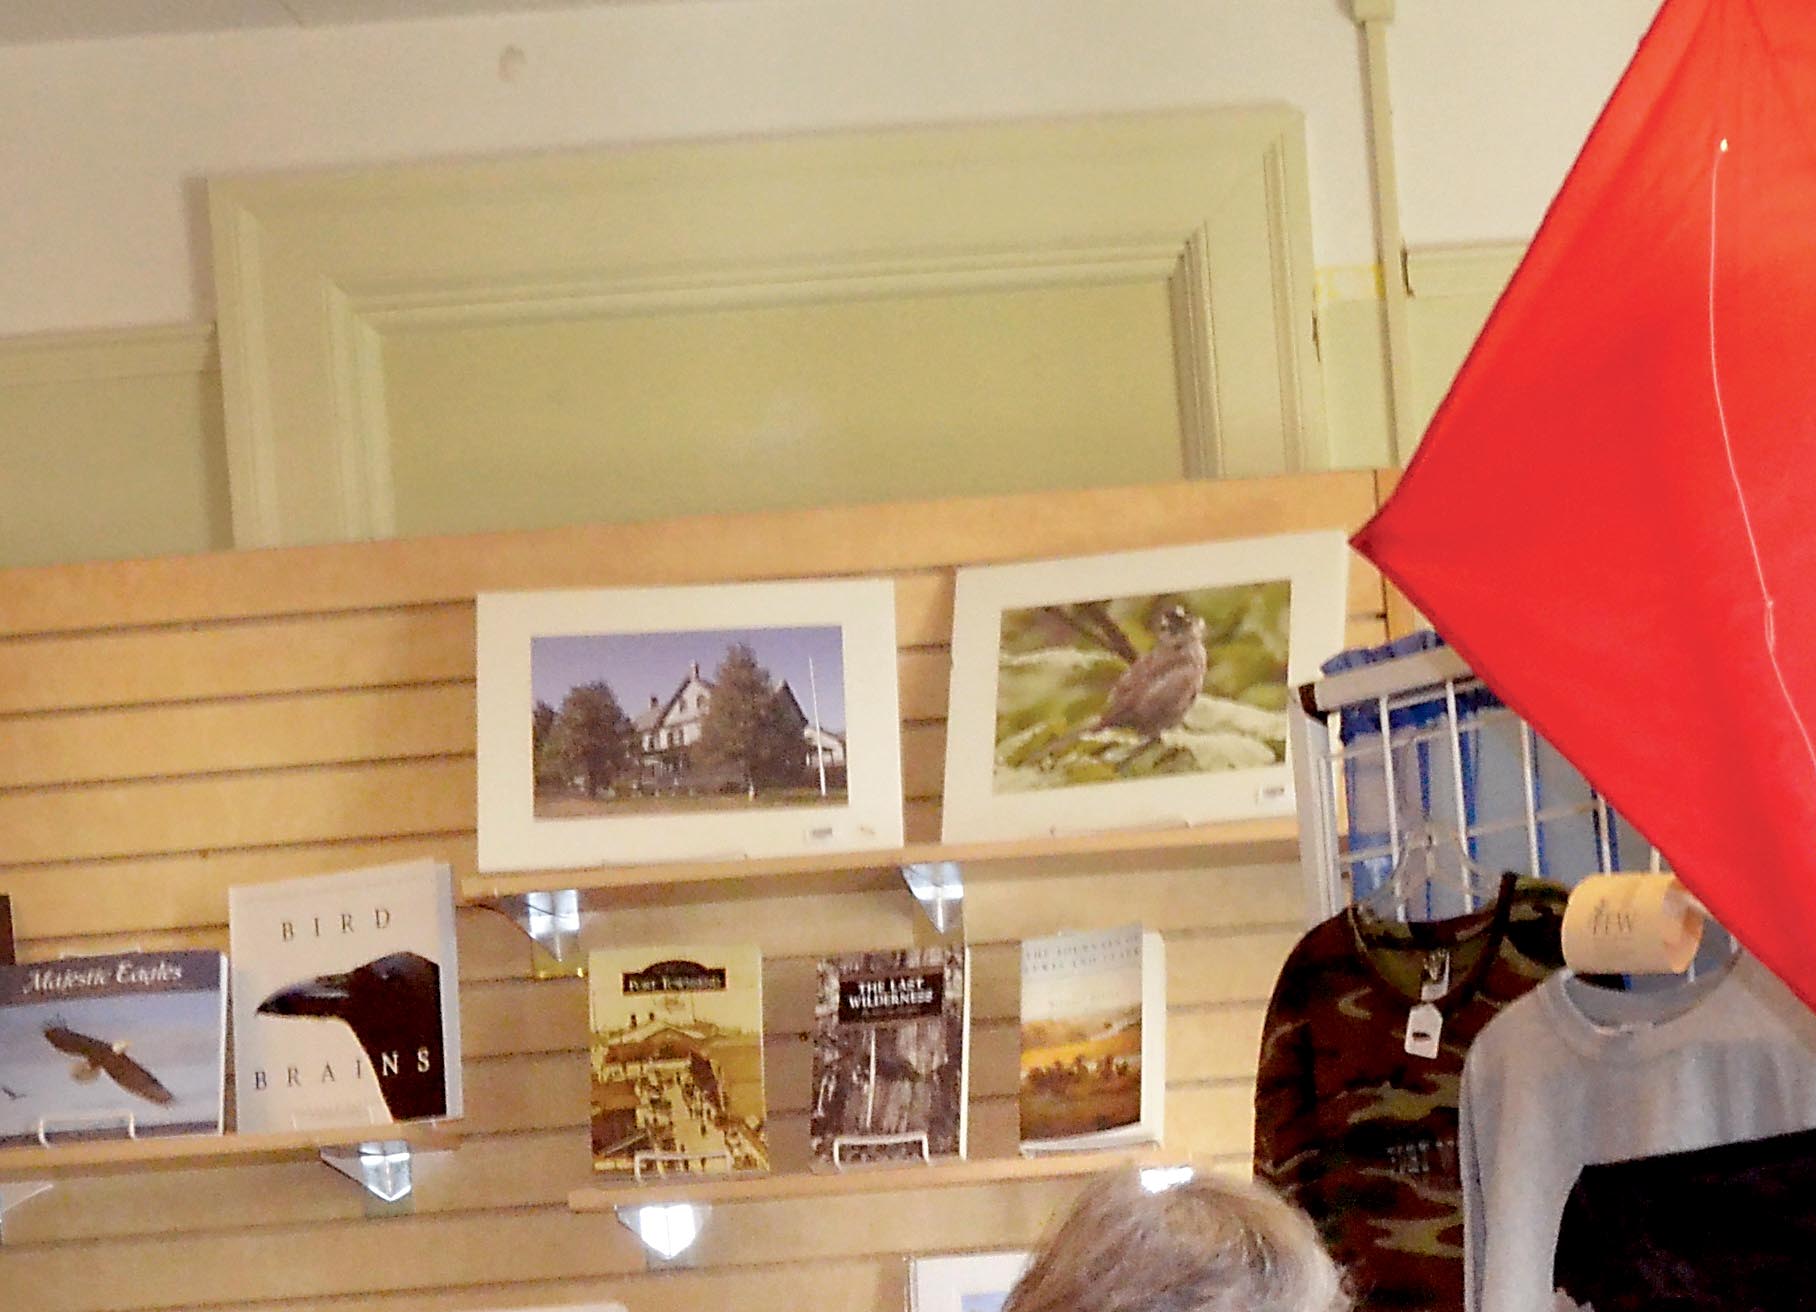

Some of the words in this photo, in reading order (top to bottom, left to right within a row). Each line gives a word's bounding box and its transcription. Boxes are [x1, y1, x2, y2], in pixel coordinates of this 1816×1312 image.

[280, 906, 393, 942] BIRD
[22, 967, 107, 994] Majestic
[116, 960, 182, 986] Eagles
[858, 980, 885, 995] THE
[889, 977, 925, 992] LAST
[848, 988, 934, 1009] WILDERNESS
[253, 1045, 432, 1091] BRAINS
